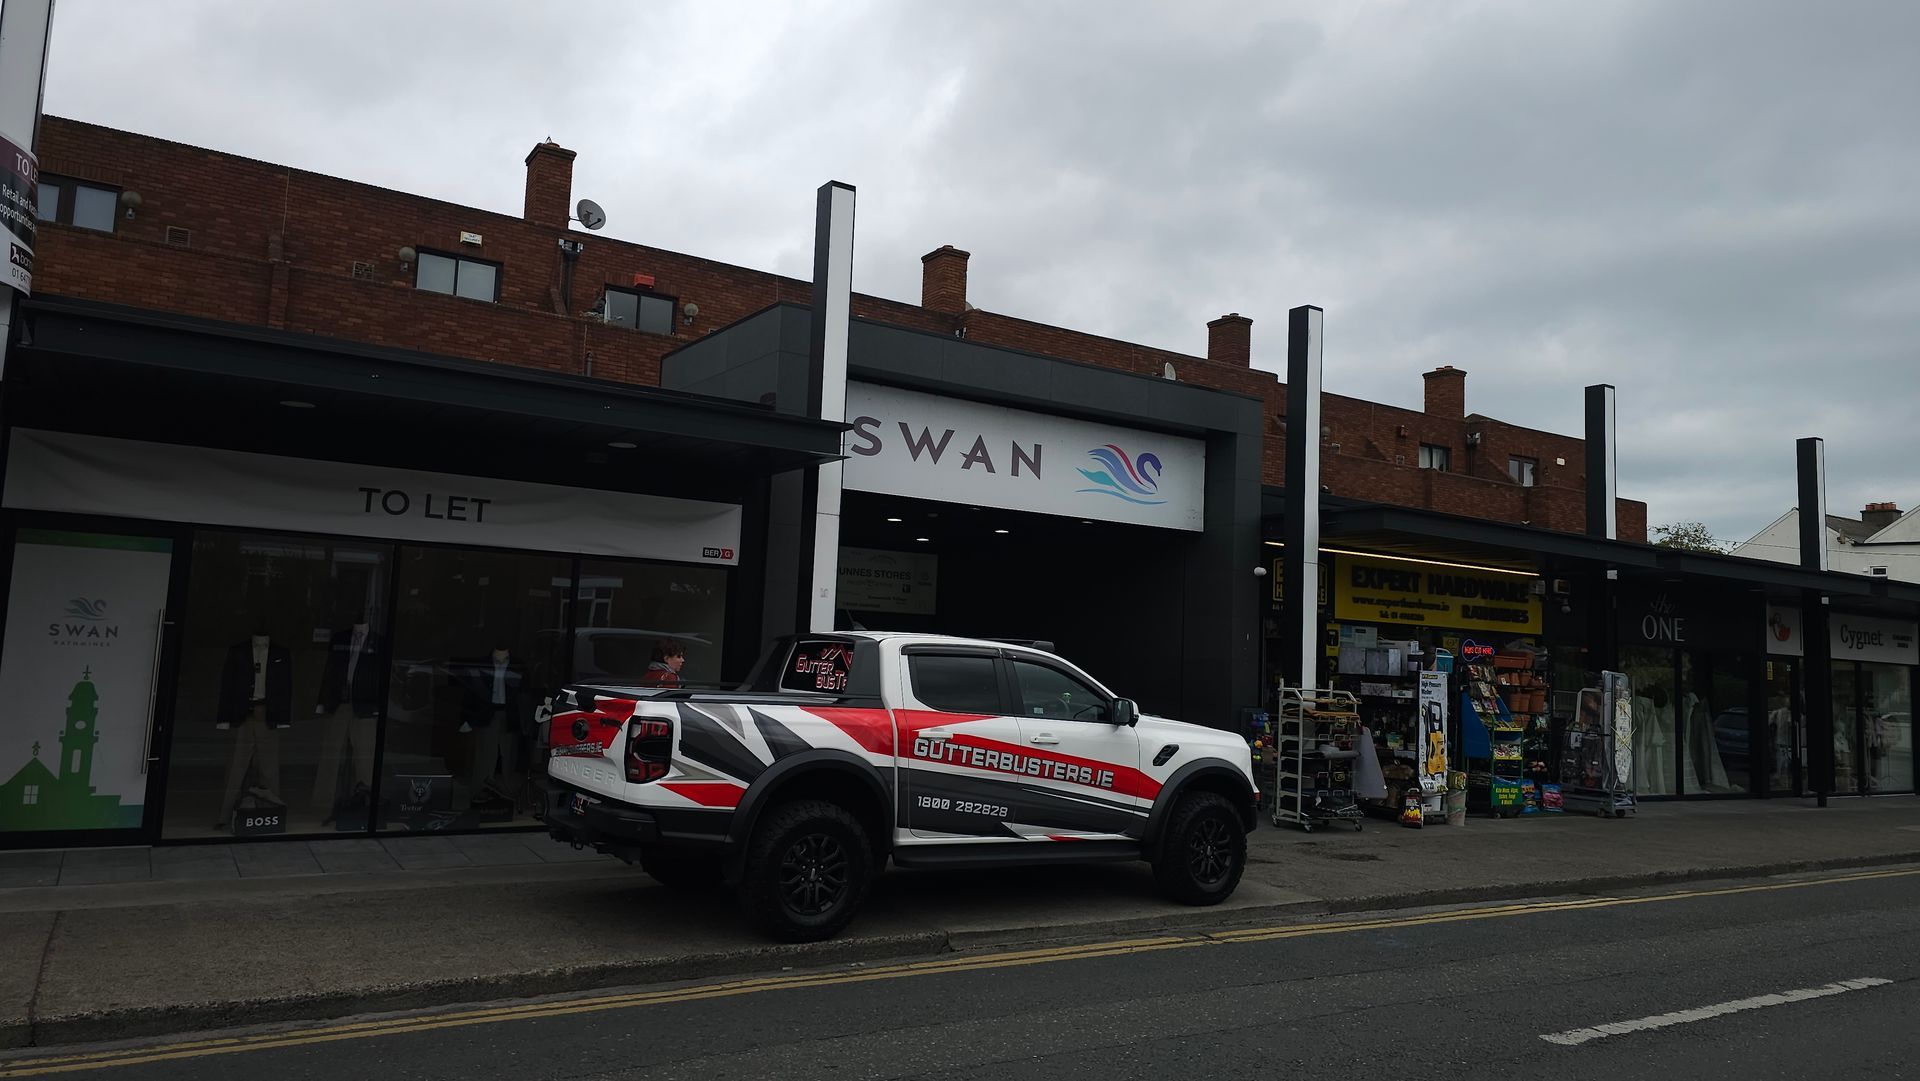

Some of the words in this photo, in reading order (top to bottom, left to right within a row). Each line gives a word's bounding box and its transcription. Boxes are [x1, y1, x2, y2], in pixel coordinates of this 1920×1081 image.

[15, 152, 29, 176] TO
[2, 183, 19, 206] Retail
[19, 195, 29, 210] and
[0, 203, 33, 231] opportunities
[11, 267, 19, 280] 01
[851, 416, 1042, 480] SWAN
[359, 487, 410, 515] TO
[425, 494, 491, 522] LET
[839, 567, 872, 578] UNNES
[874, 569, 911, 580] STORES
[1352, 565, 1421, 593] EXPERT
[1428, 573, 1529, 603] HARDWARE
[49, 623, 118, 638] SWAN
[1642, 615, 1686, 641] ONE
[1840, 624, 1883, 649] Cygnet
[796, 654, 834, 674] GUTTER
[913, 737, 1115, 788] GUTTERBUSTERS.IE
[917, 795, 951, 811] 1800
[955, 800, 1008, 818] 282828
[246, 816, 279, 828] BOSS
